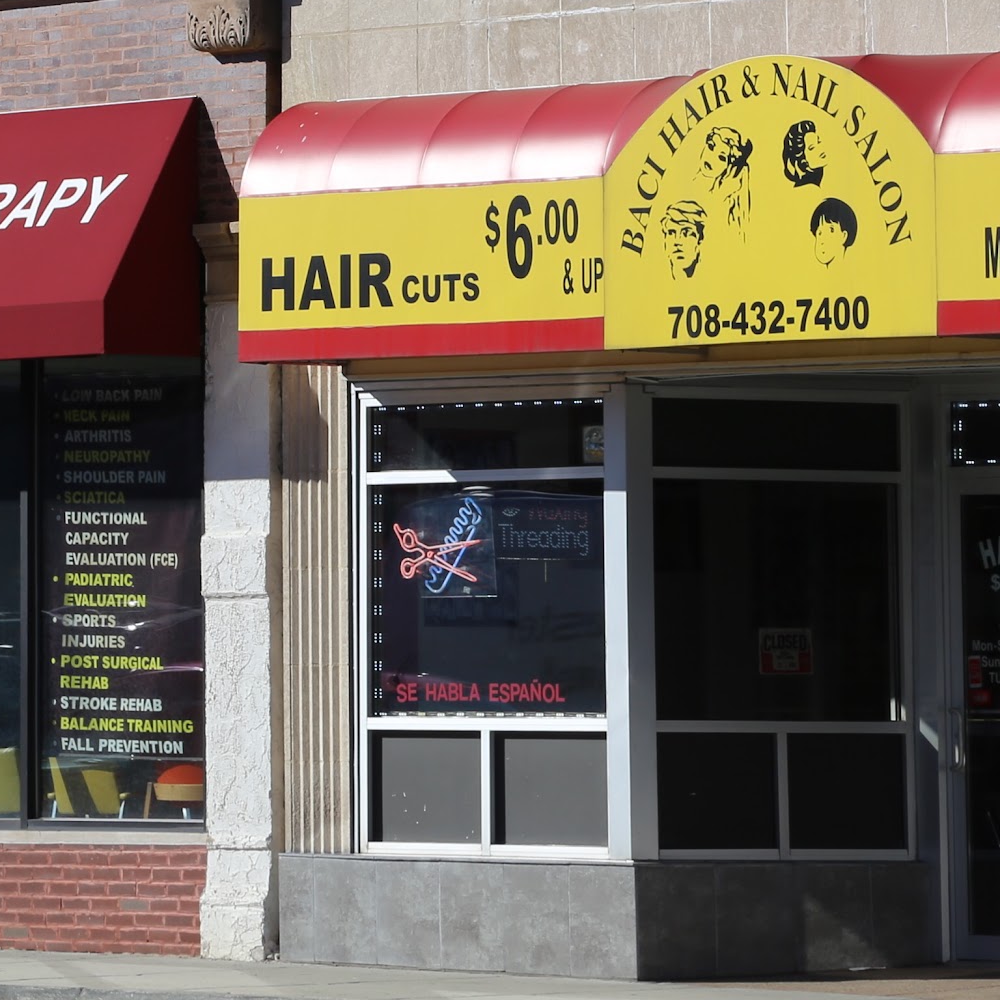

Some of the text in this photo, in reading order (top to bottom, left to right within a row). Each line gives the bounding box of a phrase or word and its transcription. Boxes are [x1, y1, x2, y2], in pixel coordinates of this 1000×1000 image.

[621, 62, 912, 257] BACI HAIR & NAIL SALON
[261, 252, 480, 312] HAIR CUTS
[563, 257, 604, 295] & UP
[668, 295, 870, 339] 708-432-7400
[95, 389, 130, 402] BACK
[133, 387, 163, 401] PAIN
[63, 409, 130, 423] NECK PAIN
[63, 429, 132, 443] ARTHRITIS
[63, 450, 151, 463] NEUROPATHY
[63, 470, 166, 484] SHOULDER PAIN
[63, 490, 126, 504] SCIATICA
[64, 511, 148, 525] FUNCTIONAL
[65, 532, 129, 545] CAPACITY
[498, 523, 589, 556] Threading
[65, 552, 178, 569] EVALUATION (FCE)
[65, 573, 134, 586] PADIATRIC
[63, 593, 146, 608] EVALUATION
[62, 614, 116, 628] SPORTS
[61, 634, 126, 648] INJURIES
[764, 634, 807, 650] CLOSED
[60, 655, 164, 670] POST SURGICAL
[60, 675, 109, 689] REHAB
[396, 679, 565, 702] SE HABLA ESPAÑOL
[60, 696, 163, 712] STROKE REHAB
[60, 717, 194, 733] BALANCE TRAINING
[61, 737, 184, 754] FALL PREVENTION
